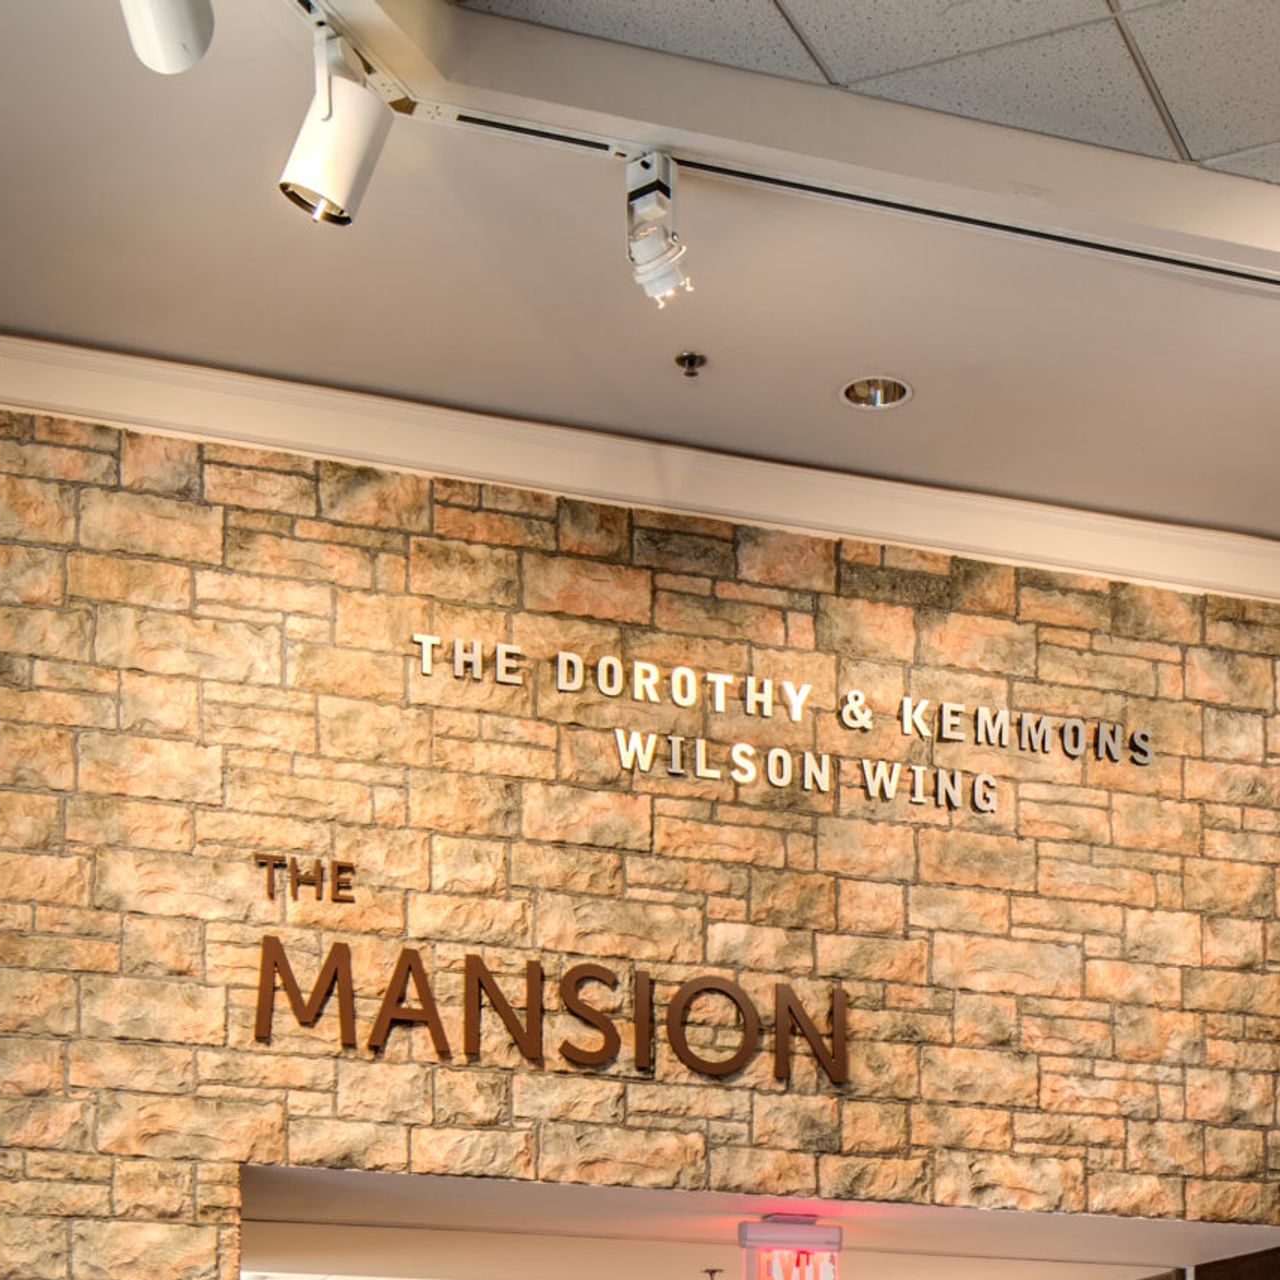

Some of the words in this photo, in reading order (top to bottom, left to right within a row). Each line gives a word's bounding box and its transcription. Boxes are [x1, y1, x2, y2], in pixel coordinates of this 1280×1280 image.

[412, 633, 523, 685] THE
[556, 651, 812, 722] DOROTHY
[841, 689, 873, 729] &
[901, 696, 1155, 766] KEMMONS
[615, 728, 830, 793] WILSON
[861, 759, 998, 813] WING
[254, 853, 357, 903] THE
[254, 935, 851, 1084] MANSION
